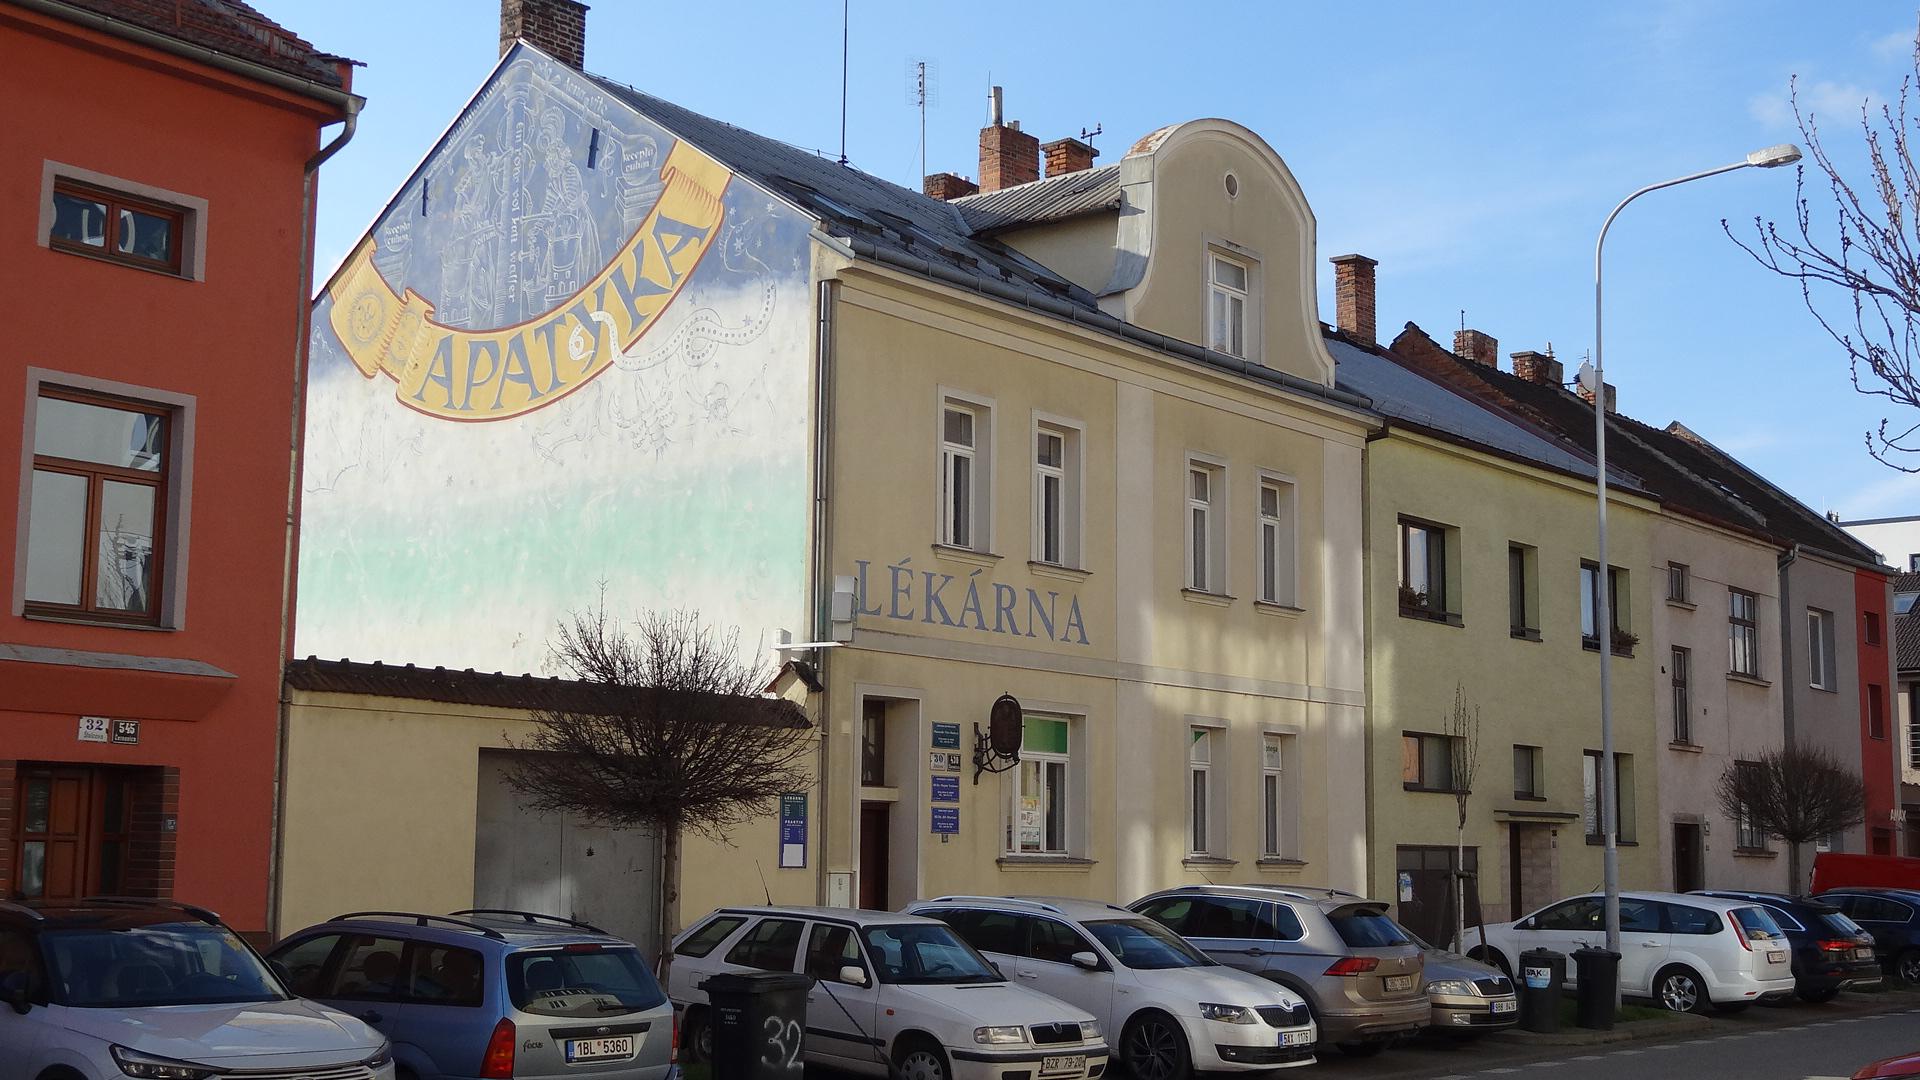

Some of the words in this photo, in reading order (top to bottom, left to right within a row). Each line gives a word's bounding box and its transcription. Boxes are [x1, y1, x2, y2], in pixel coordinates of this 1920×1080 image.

[415, 213, 712, 411] APATYKA
[854, 557, 1091, 646] LÉKÁRNA
[86, 719, 104, 731] 32
[118, 722, 136, 735] 545
[933, 754, 944, 763] 30
[577, 1041, 596, 1056] 1BL
[603, 1038, 628, 1054] 5360
[761, 1015, 804, 1069] 32
